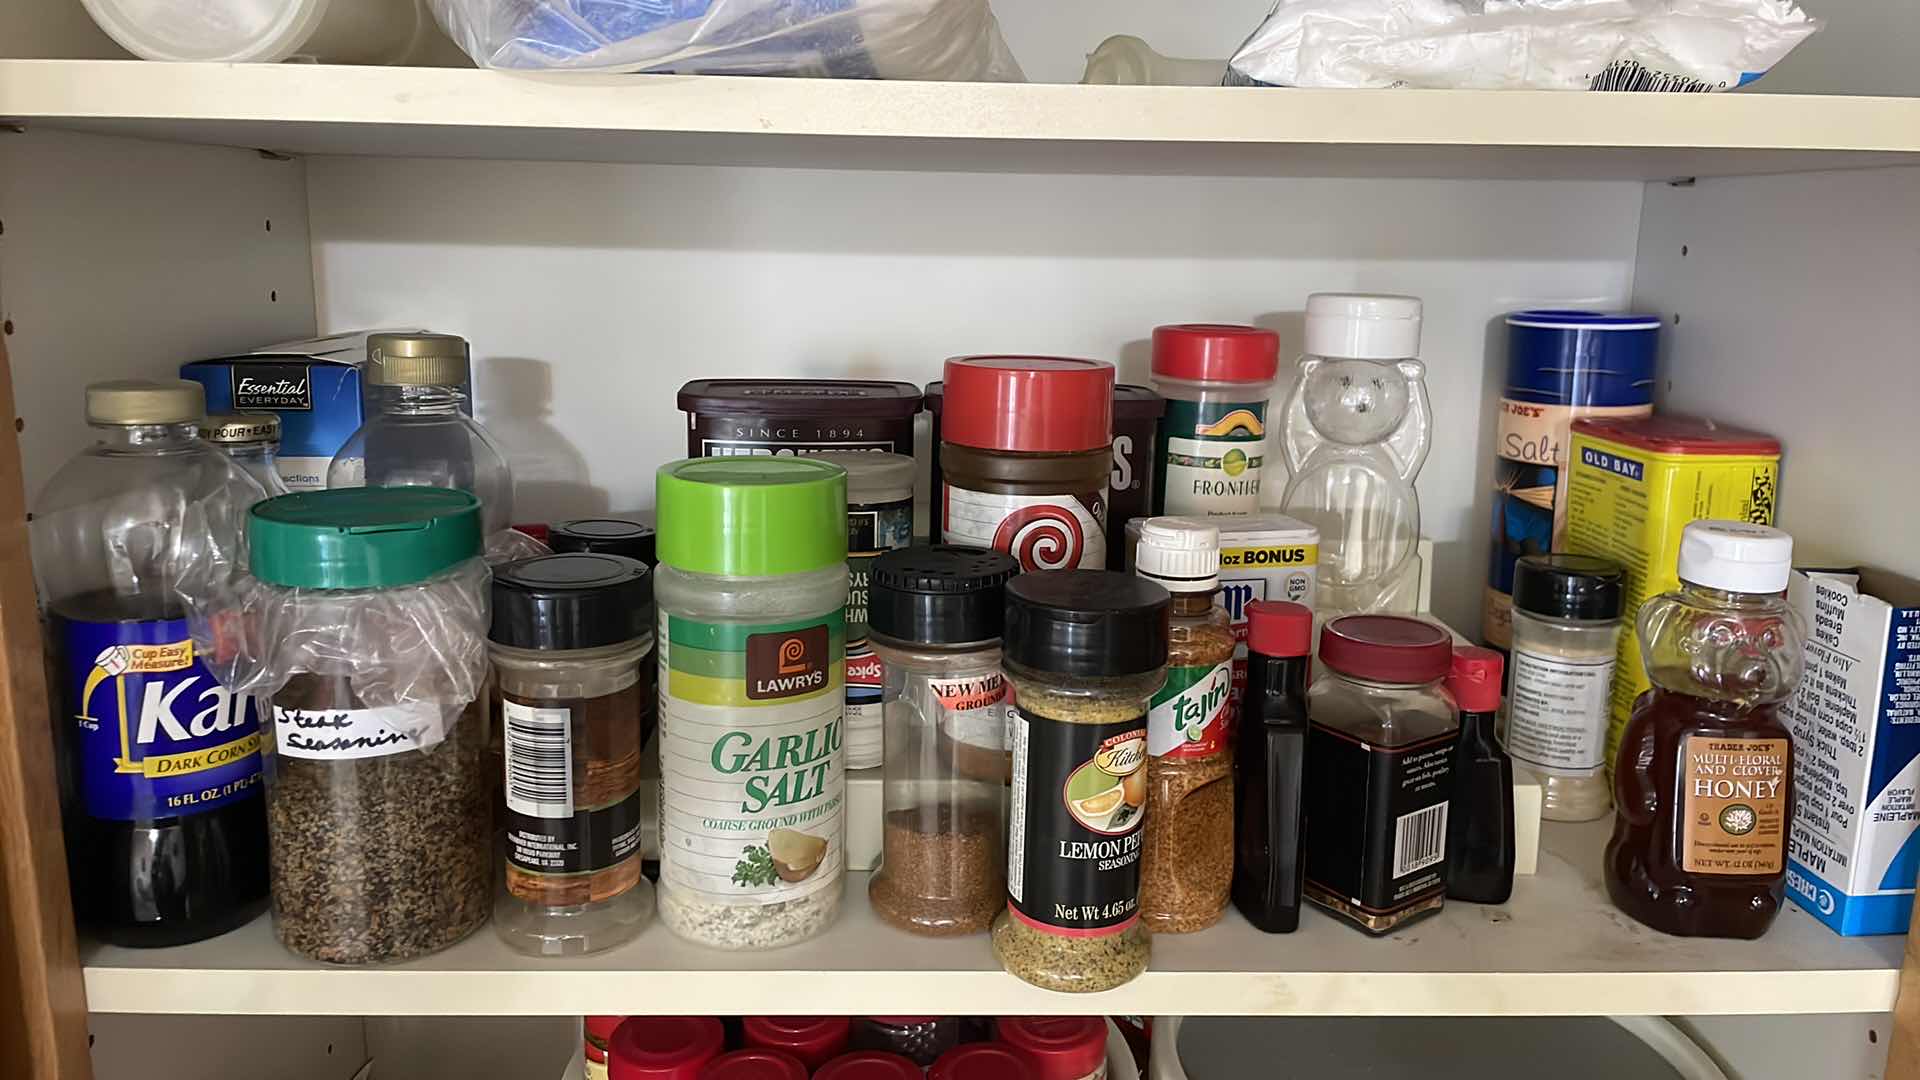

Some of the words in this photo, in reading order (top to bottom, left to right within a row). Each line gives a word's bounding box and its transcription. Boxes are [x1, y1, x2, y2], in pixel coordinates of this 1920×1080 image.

[238, 378, 306, 395] Essential
[240, 396, 304, 404] EVERYDAY
[214, 428, 245, 438] POUR
[736, 428, 800, 438] SINCE
[816, 429, 864, 438] 1894
[1506, 433, 1560, 464] Salt
[1586, 451, 1608, 467] OLD
[1615, 460, 1636, 476] BAY
[1244, 549, 1304, 564] BONUS
[1816, 585, 1848, 606] Cookies
[1816, 599, 1845, 621] Muffins
[1816, 614, 1842, 634] Breads
[1816, 628, 1839, 648] Cakes
[131, 656, 189, 670] Measure!
[132, 649, 158, 661] Cup
[160, 647, 186, 658] Easy
[1833, 655, 1853, 672] Also
[848, 662, 881, 678] Spice
[1825, 670, 1847, 690] Makes
[931, 683, 975, 697] NEW
[1807, 691, 1820, 706] Boil
[1826, 684, 1856, 709] Thickens
[137, 676, 248, 744] Kar
[278, 709, 352, 730] Steak
[1818, 709, 1833, 724] corn
[1836, 719, 1853, 734] cups
[711, 716, 843, 774] GARLIC
[1793, 726, 1815, 748] Syrup
[157, 756, 202, 773] DARK
[207, 746, 245, 764] CORN
[1817, 738, 1836, 761] Thick
[1858, 745, 1864, 757] 2
[1695, 765, 1725, 776] AND
[1733, 766, 1778, 776] CLOVER
[1818, 759, 1839, 779] Makes
[741, 760, 831, 813] SALT
[1695, 779, 1781, 799] HONEY
[1834, 782, 1848, 798] tsp.
[168, 797, 181, 807] 16
[1832, 796, 1837, 806] 2
[1838, 801, 1854, 815] over
[703, 817, 745, 831] COARSE
[750, 815, 797, 831] GROUND
[800, 804, 824, 825] WITH
[1804, 809, 1829, 833] Instant
[1831, 811, 1848, 828] Pour
[1792, 823, 1810, 844] MAPL
[1059, 840, 1121, 859] LEMON
[1789, 839, 1826, 873] MAPLE
[1812, 838, 1847, 868] IMITATION
[1054, 904, 1078, 920] Net
[1081, 906, 1100, 920] Wt
[1102, 900, 1124, 919] 4.65
